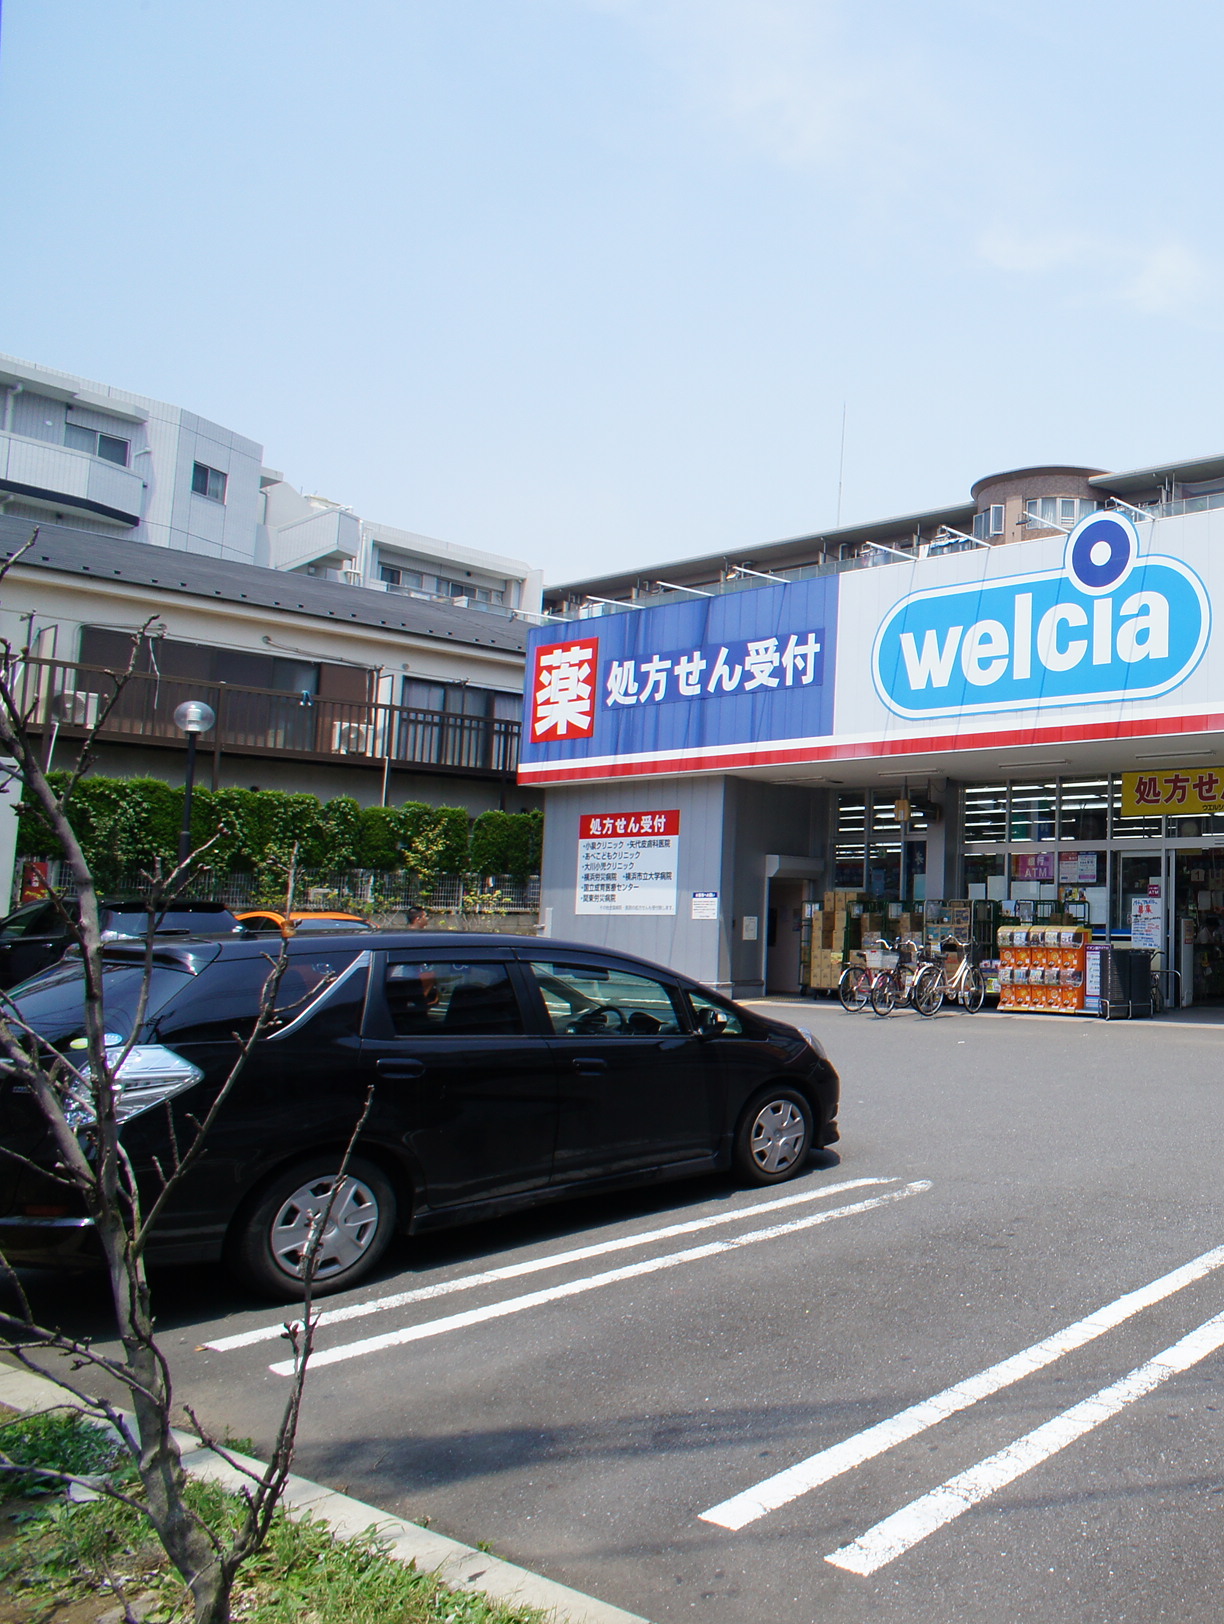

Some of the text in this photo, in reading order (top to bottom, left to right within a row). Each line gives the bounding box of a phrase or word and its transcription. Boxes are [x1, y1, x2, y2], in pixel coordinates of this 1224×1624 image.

[606, 633, 820, 707] 処方せん受付
[899, 590, 1170, 691] welcia
[534, 646, 593, 736] 薬
[589, 815, 667, 835] 処方せん受付
[1024, 867, 1047, 878] ATM
